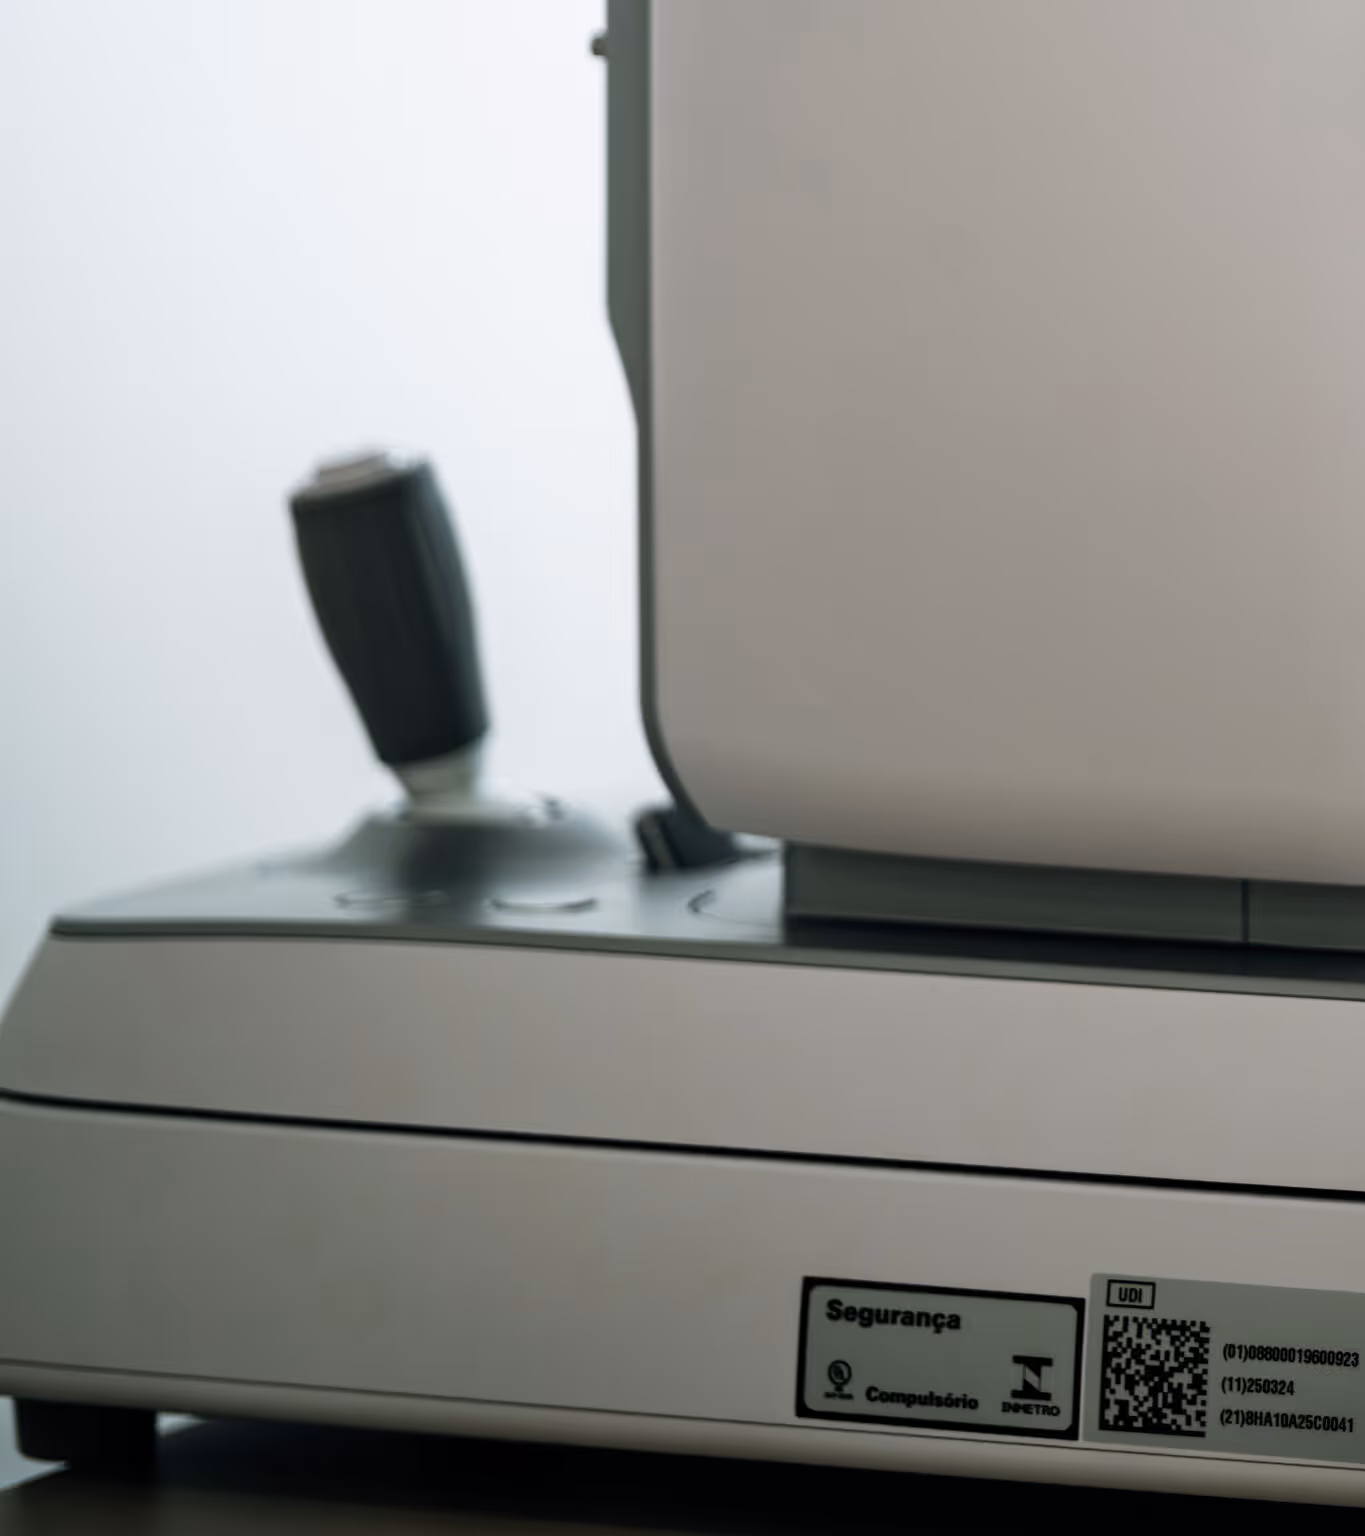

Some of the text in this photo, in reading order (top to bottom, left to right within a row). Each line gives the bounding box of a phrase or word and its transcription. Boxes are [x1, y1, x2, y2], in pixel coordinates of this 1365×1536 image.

[1118, 1287, 1142, 1303] UDI
[826, 1298, 961, 1334] Segurança
[1222, 1343, 1360, 1368] (01)08800019600923
[865, 1385, 979, 1411] Compulsório
[1220, 1376, 1295, 1396] (11)250324
[1001, 1401, 1061, 1417] INMETRO
[1219, 1409, 1354, 1433] (21)8HA10A25C0041
